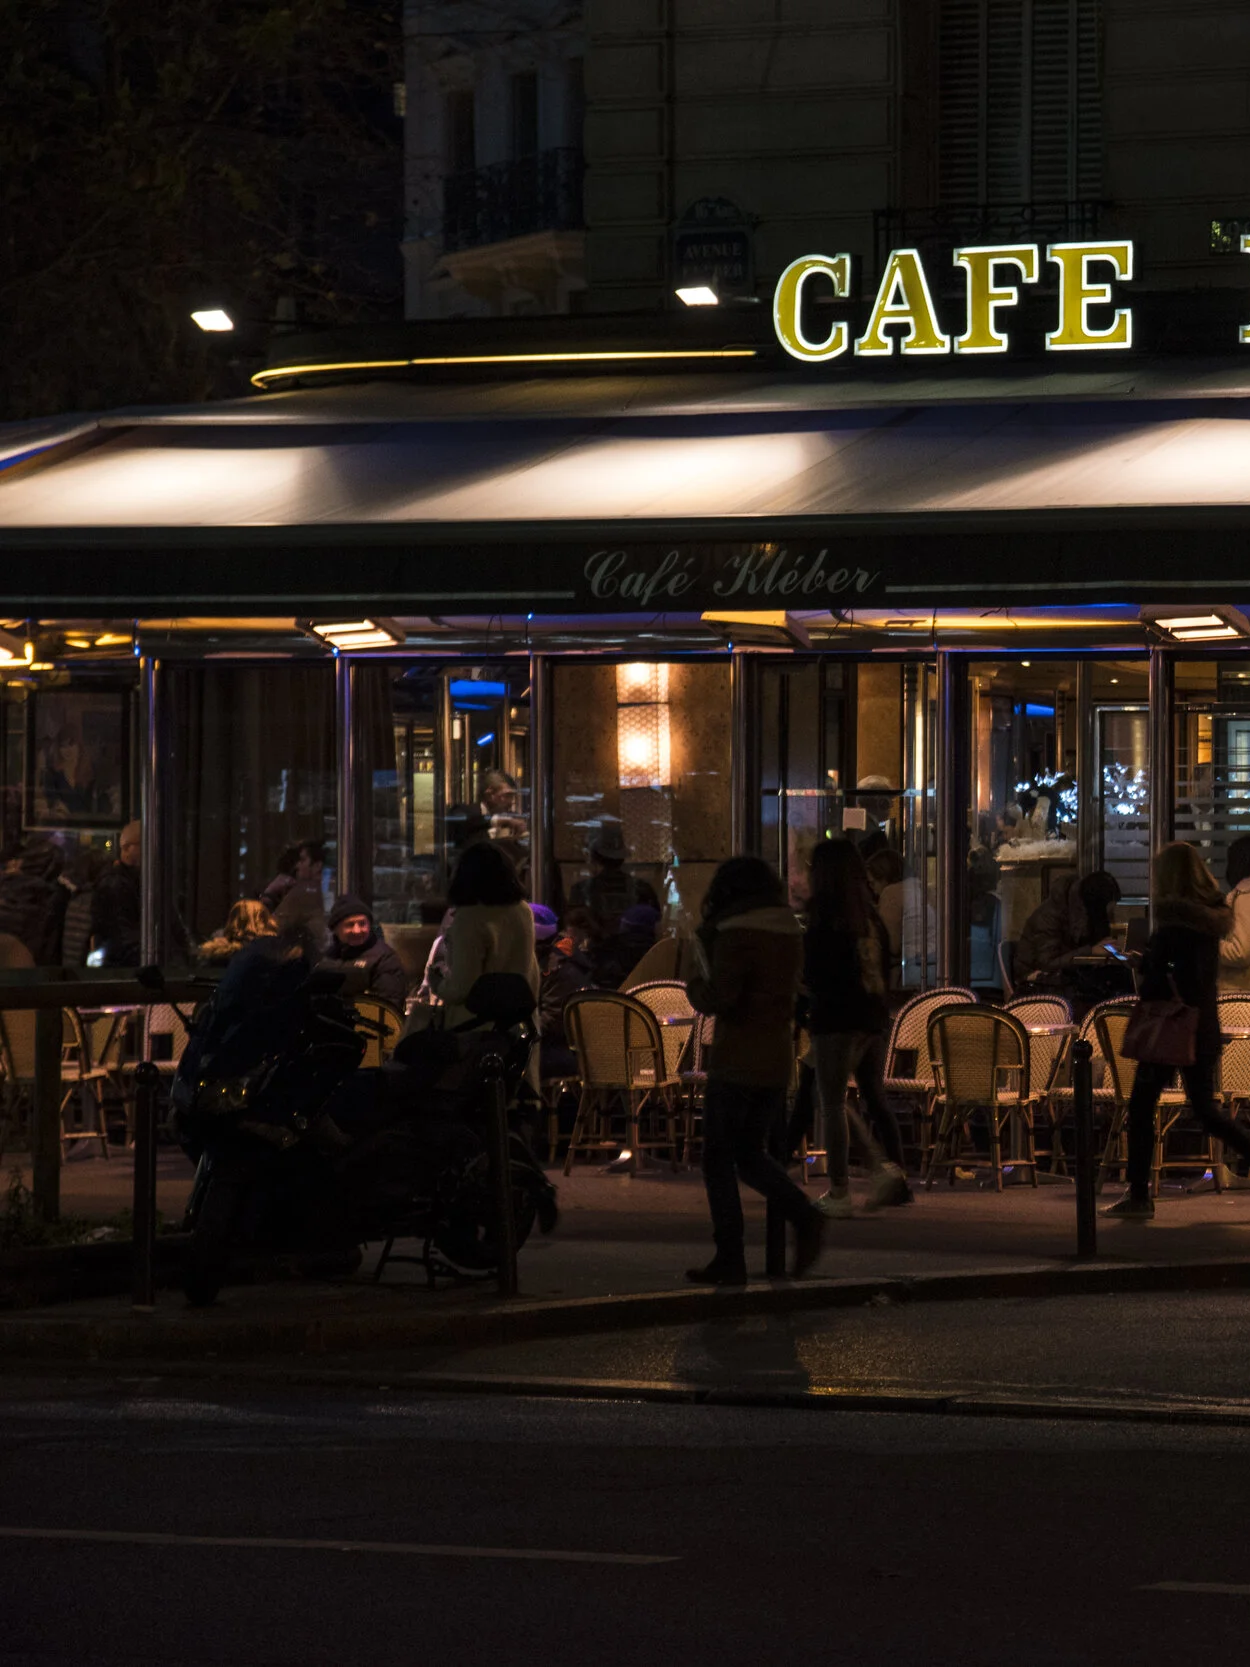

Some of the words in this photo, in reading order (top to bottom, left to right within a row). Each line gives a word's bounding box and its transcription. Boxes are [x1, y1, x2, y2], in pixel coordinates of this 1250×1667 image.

[773, 240, 1133, 362] CAFE
[584, 550, 701, 607] Café
[712, 547, 883, 597] Kléber
